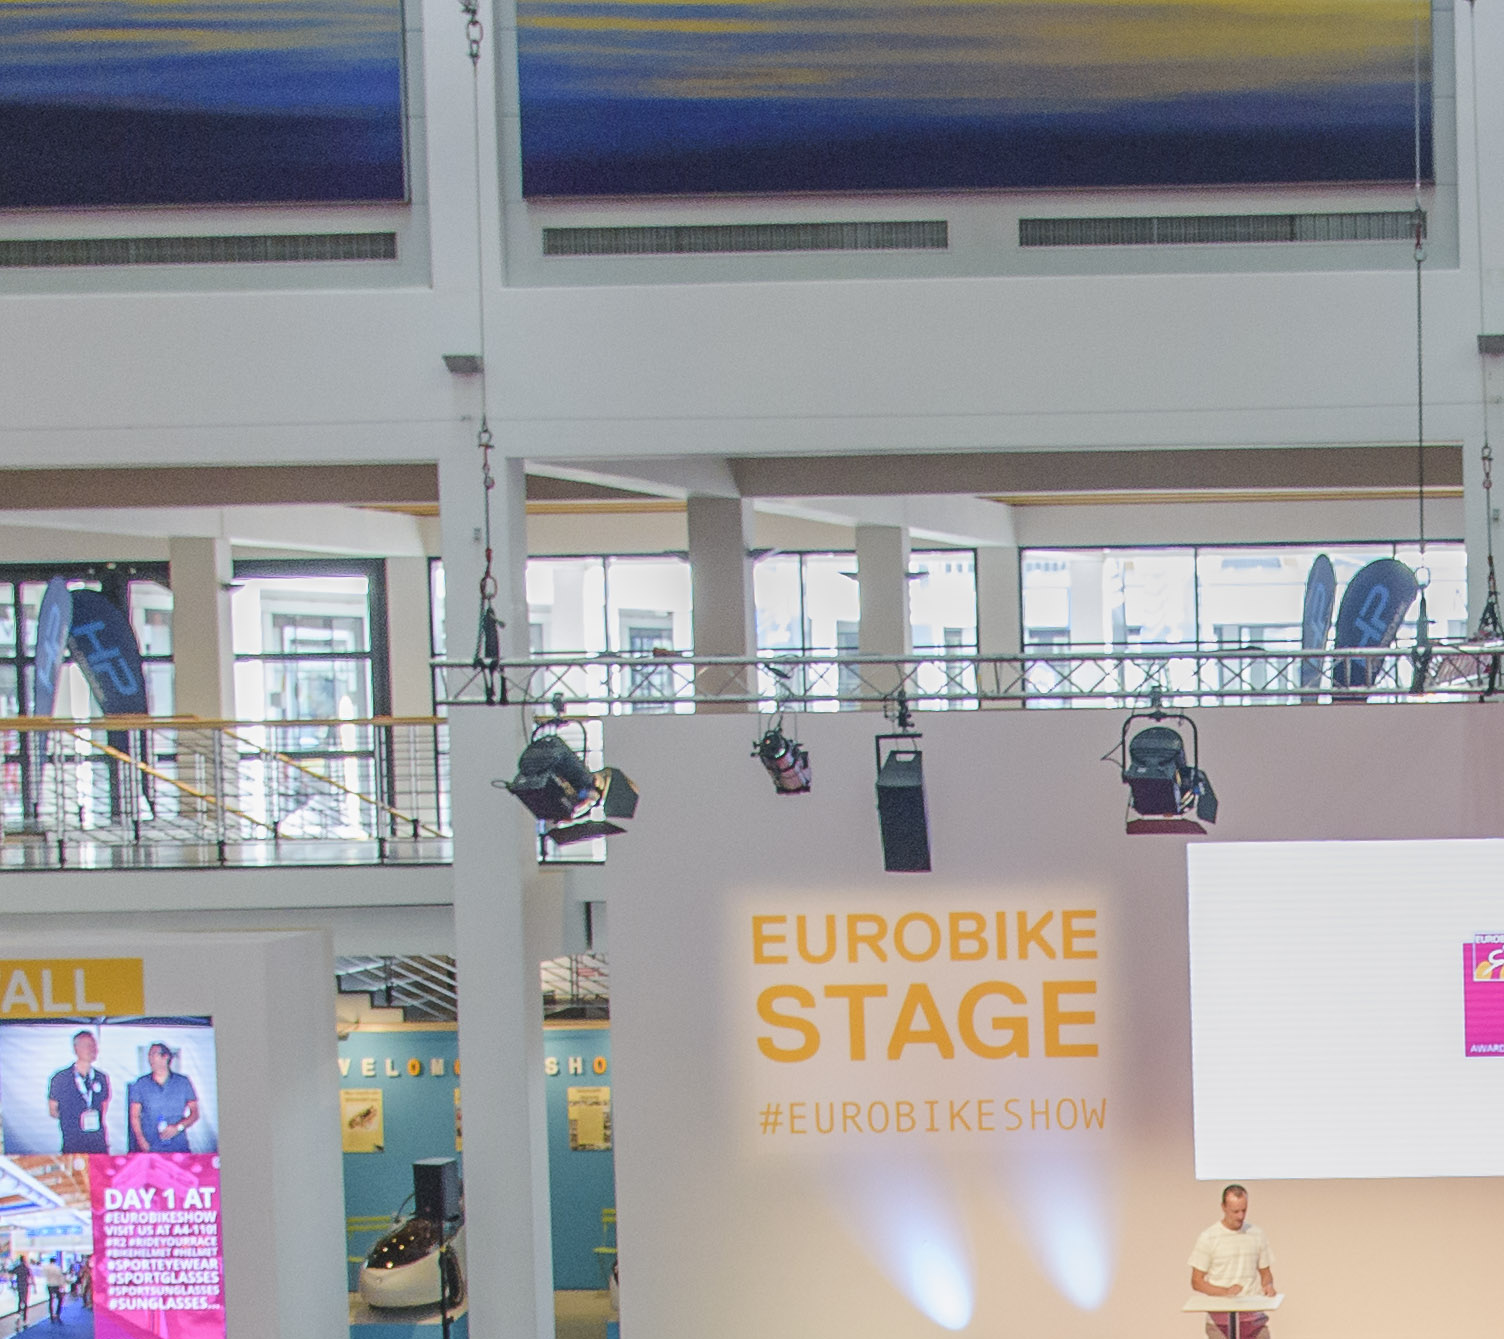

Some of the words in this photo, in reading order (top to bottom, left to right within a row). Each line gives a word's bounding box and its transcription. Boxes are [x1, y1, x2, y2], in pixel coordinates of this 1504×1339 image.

[71, 620, 139, 697] HP
[752, 910, 1100, 965] EUROBIKE
[756, 981, 1101, 1063] STAGE
[544, 1056, 608, 1076] SHO
[760, 1098, 1109, 1135] #EUROBIKESHOW
[104, 1187, 157, 1210] DAY
[162, 1187, 177, 1209] 1
[183, 1187, 217, 1209] AT
[104, 1210, 218, 1224] #EUROBIKESHOW
[104, 1223, 135, 1237] VISIT
[137, 1223, 156, 1236] US
[157, 1223, 171, 1236] AT
[106, 1257, 219, 1271] #SPORTEYEWEAR
[107, 1270, 220, 1285] #SPORTGLASSES
